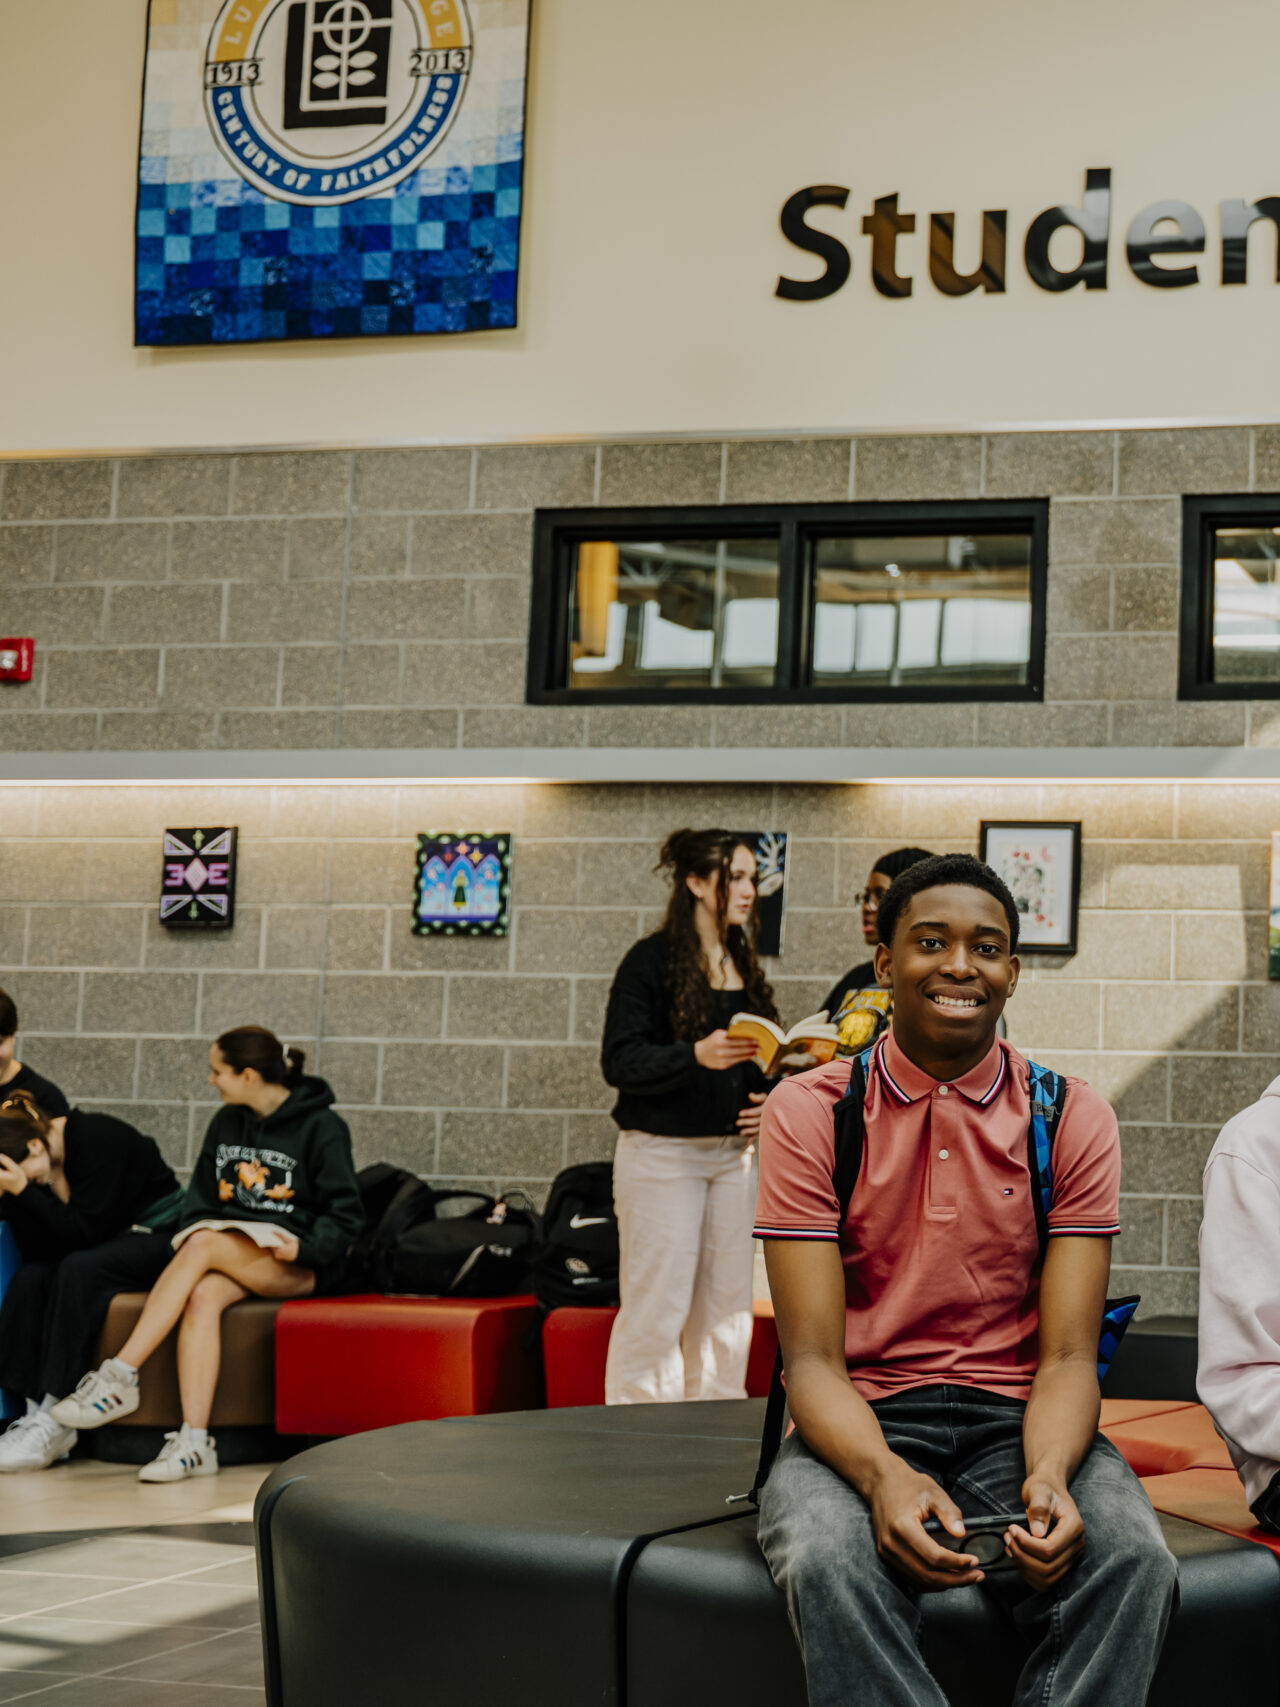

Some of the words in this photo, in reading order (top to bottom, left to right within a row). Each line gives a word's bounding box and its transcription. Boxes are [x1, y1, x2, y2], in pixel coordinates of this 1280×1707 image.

[409, 50, 466, 73] 2013
[207, 63, 260, 84] 1913
[217, 91, 281, 177] CENTURY
[283, 169, 311, 191] OF
[320, 76, 453, 192] FAITHFULNESS
